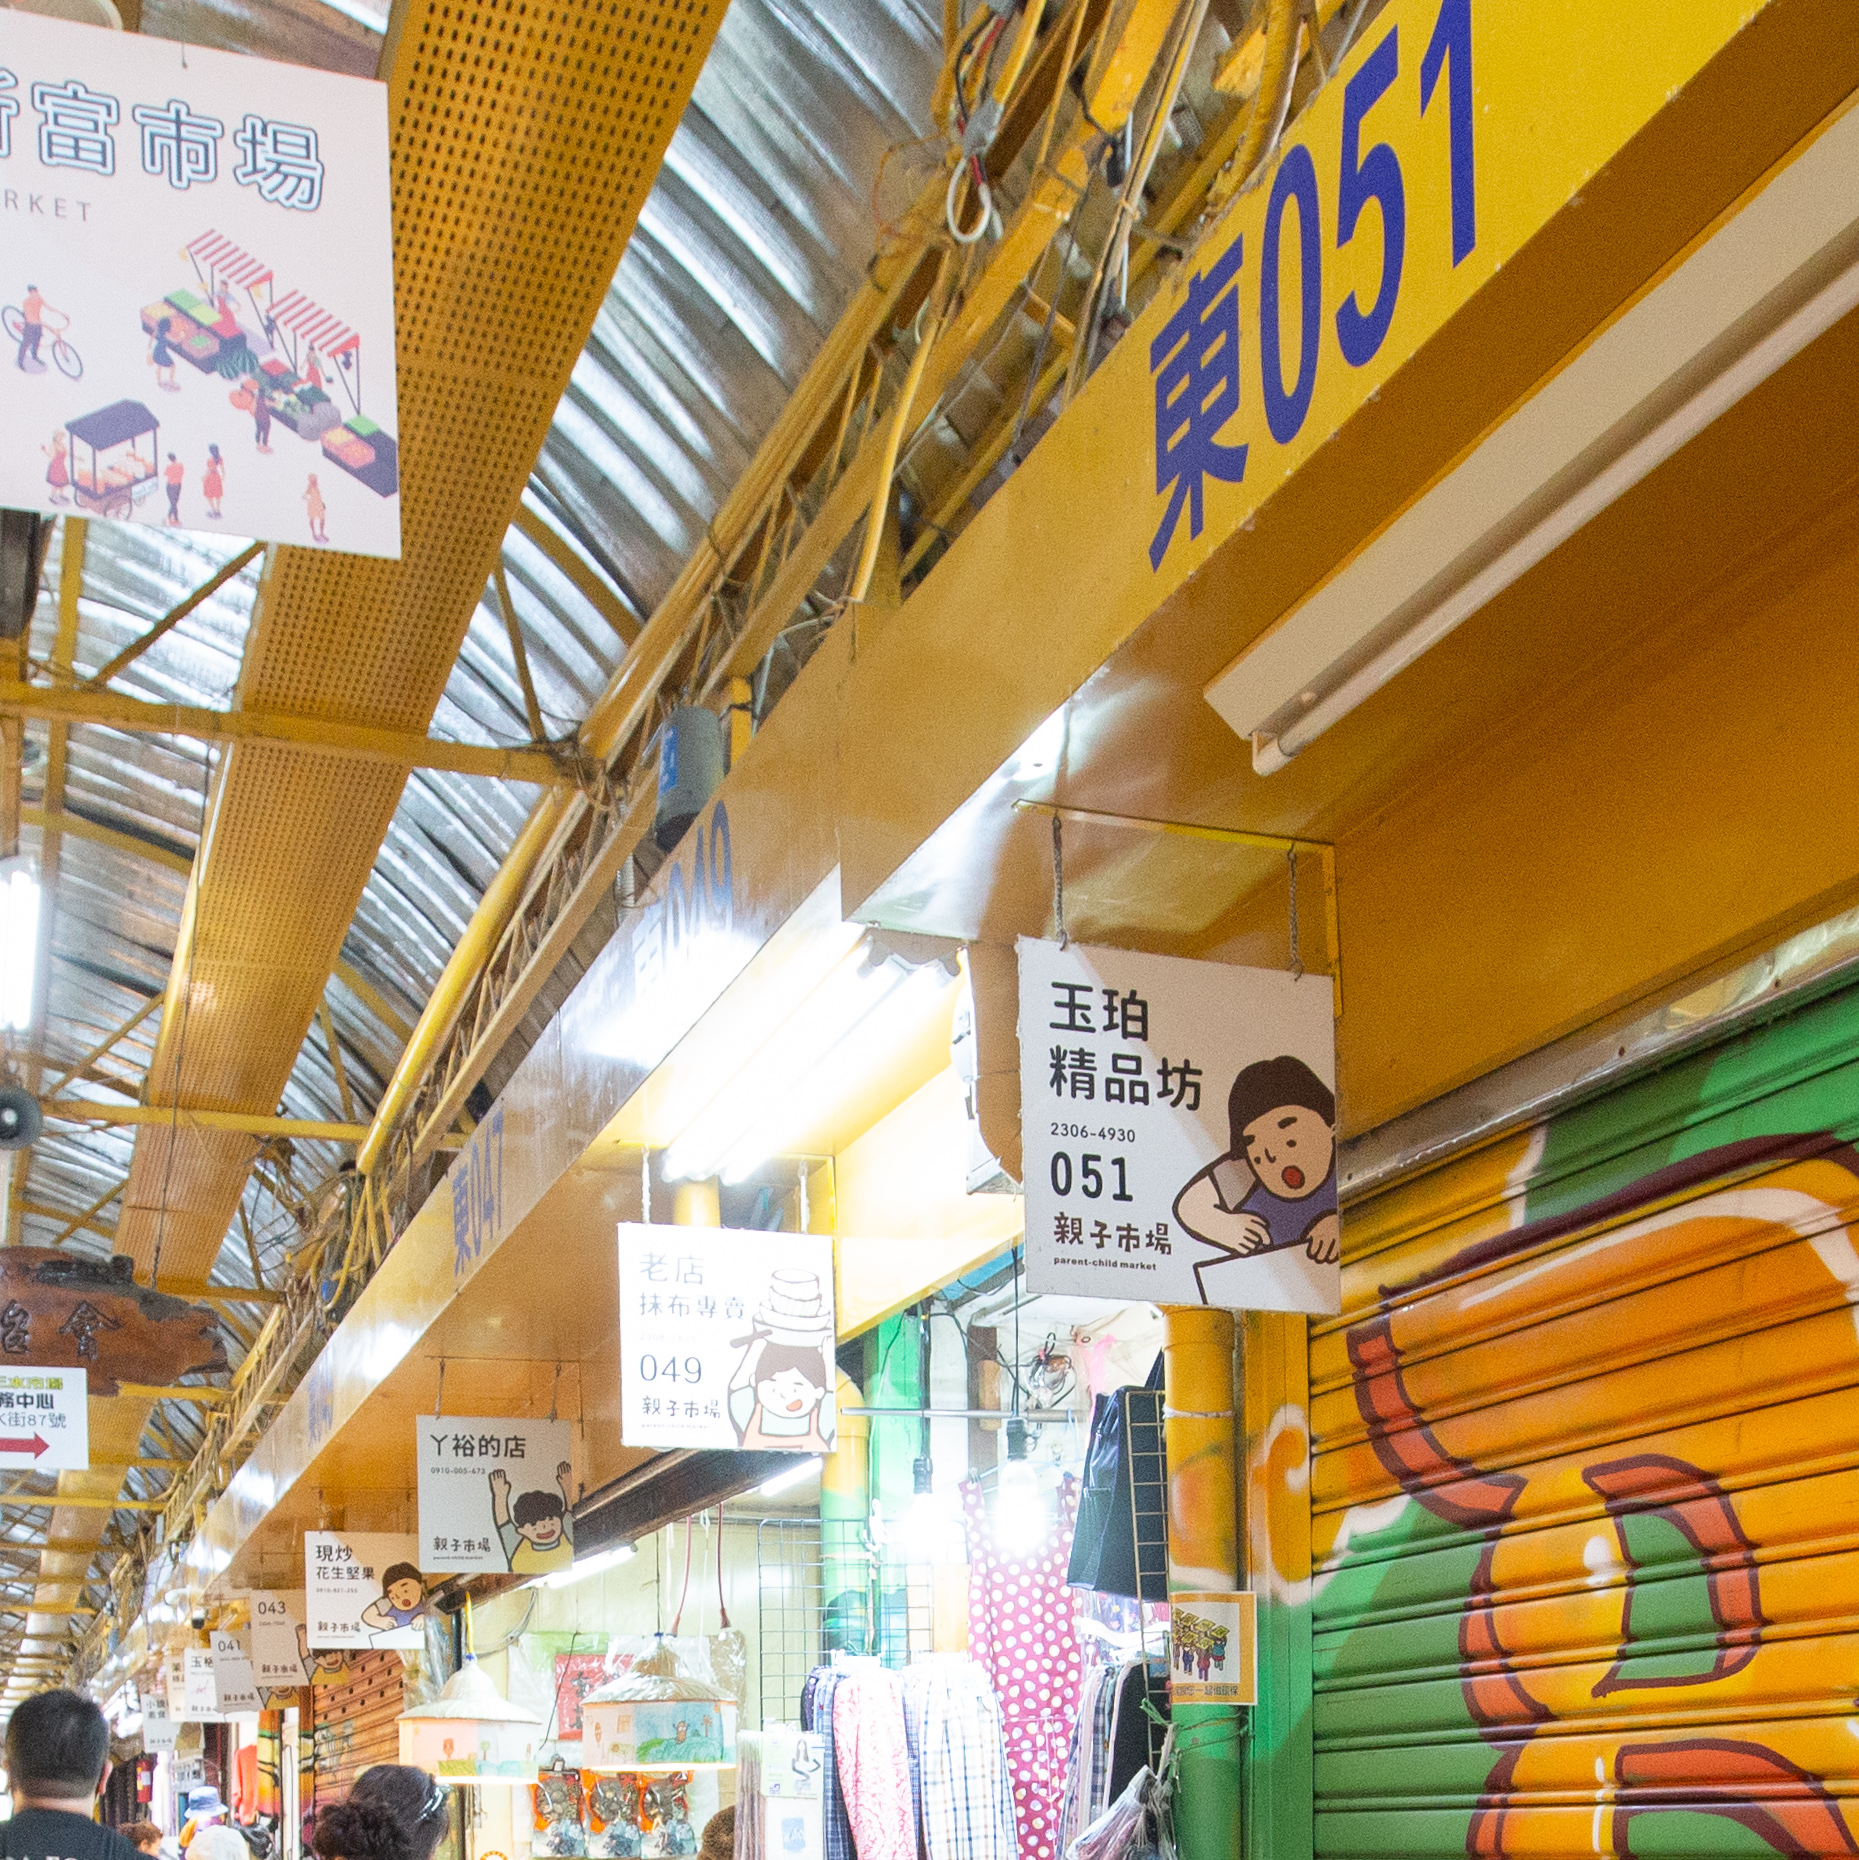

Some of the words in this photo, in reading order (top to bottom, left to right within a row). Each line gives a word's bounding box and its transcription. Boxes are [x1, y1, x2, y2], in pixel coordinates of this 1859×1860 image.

[1149, 0, 1477, 574] 東051
[1049, 981, 1149, 1042] 玉珀
[1049, 1044, 1203, 1111] 精品坊
[1050, 1122, 1136, 1143] 2306-4930
[1050, 1151, 1134, 1203] 051
[452, 1108, 504, 1277] 東047
[1053, 1210, 1173, 1256] 親子市場
[639, 1250, 705, 1285] 老店
[1053, 1256, 1118, 1269] parent-child
[1120, 1258, 1157, 1271] market
[639, 1354, 703, 1384] 049
[642, 1395, 721, 1418] 親子市場
[315, 1545, 353, 1562] 現炒
[433, 1536, 492, 1553] 親子市場
[315, 1566, 376, 1581] 花生堅果
[258, 1601, 286, 1614] 043
[317, 1621, 362, 1633] 親子市場
